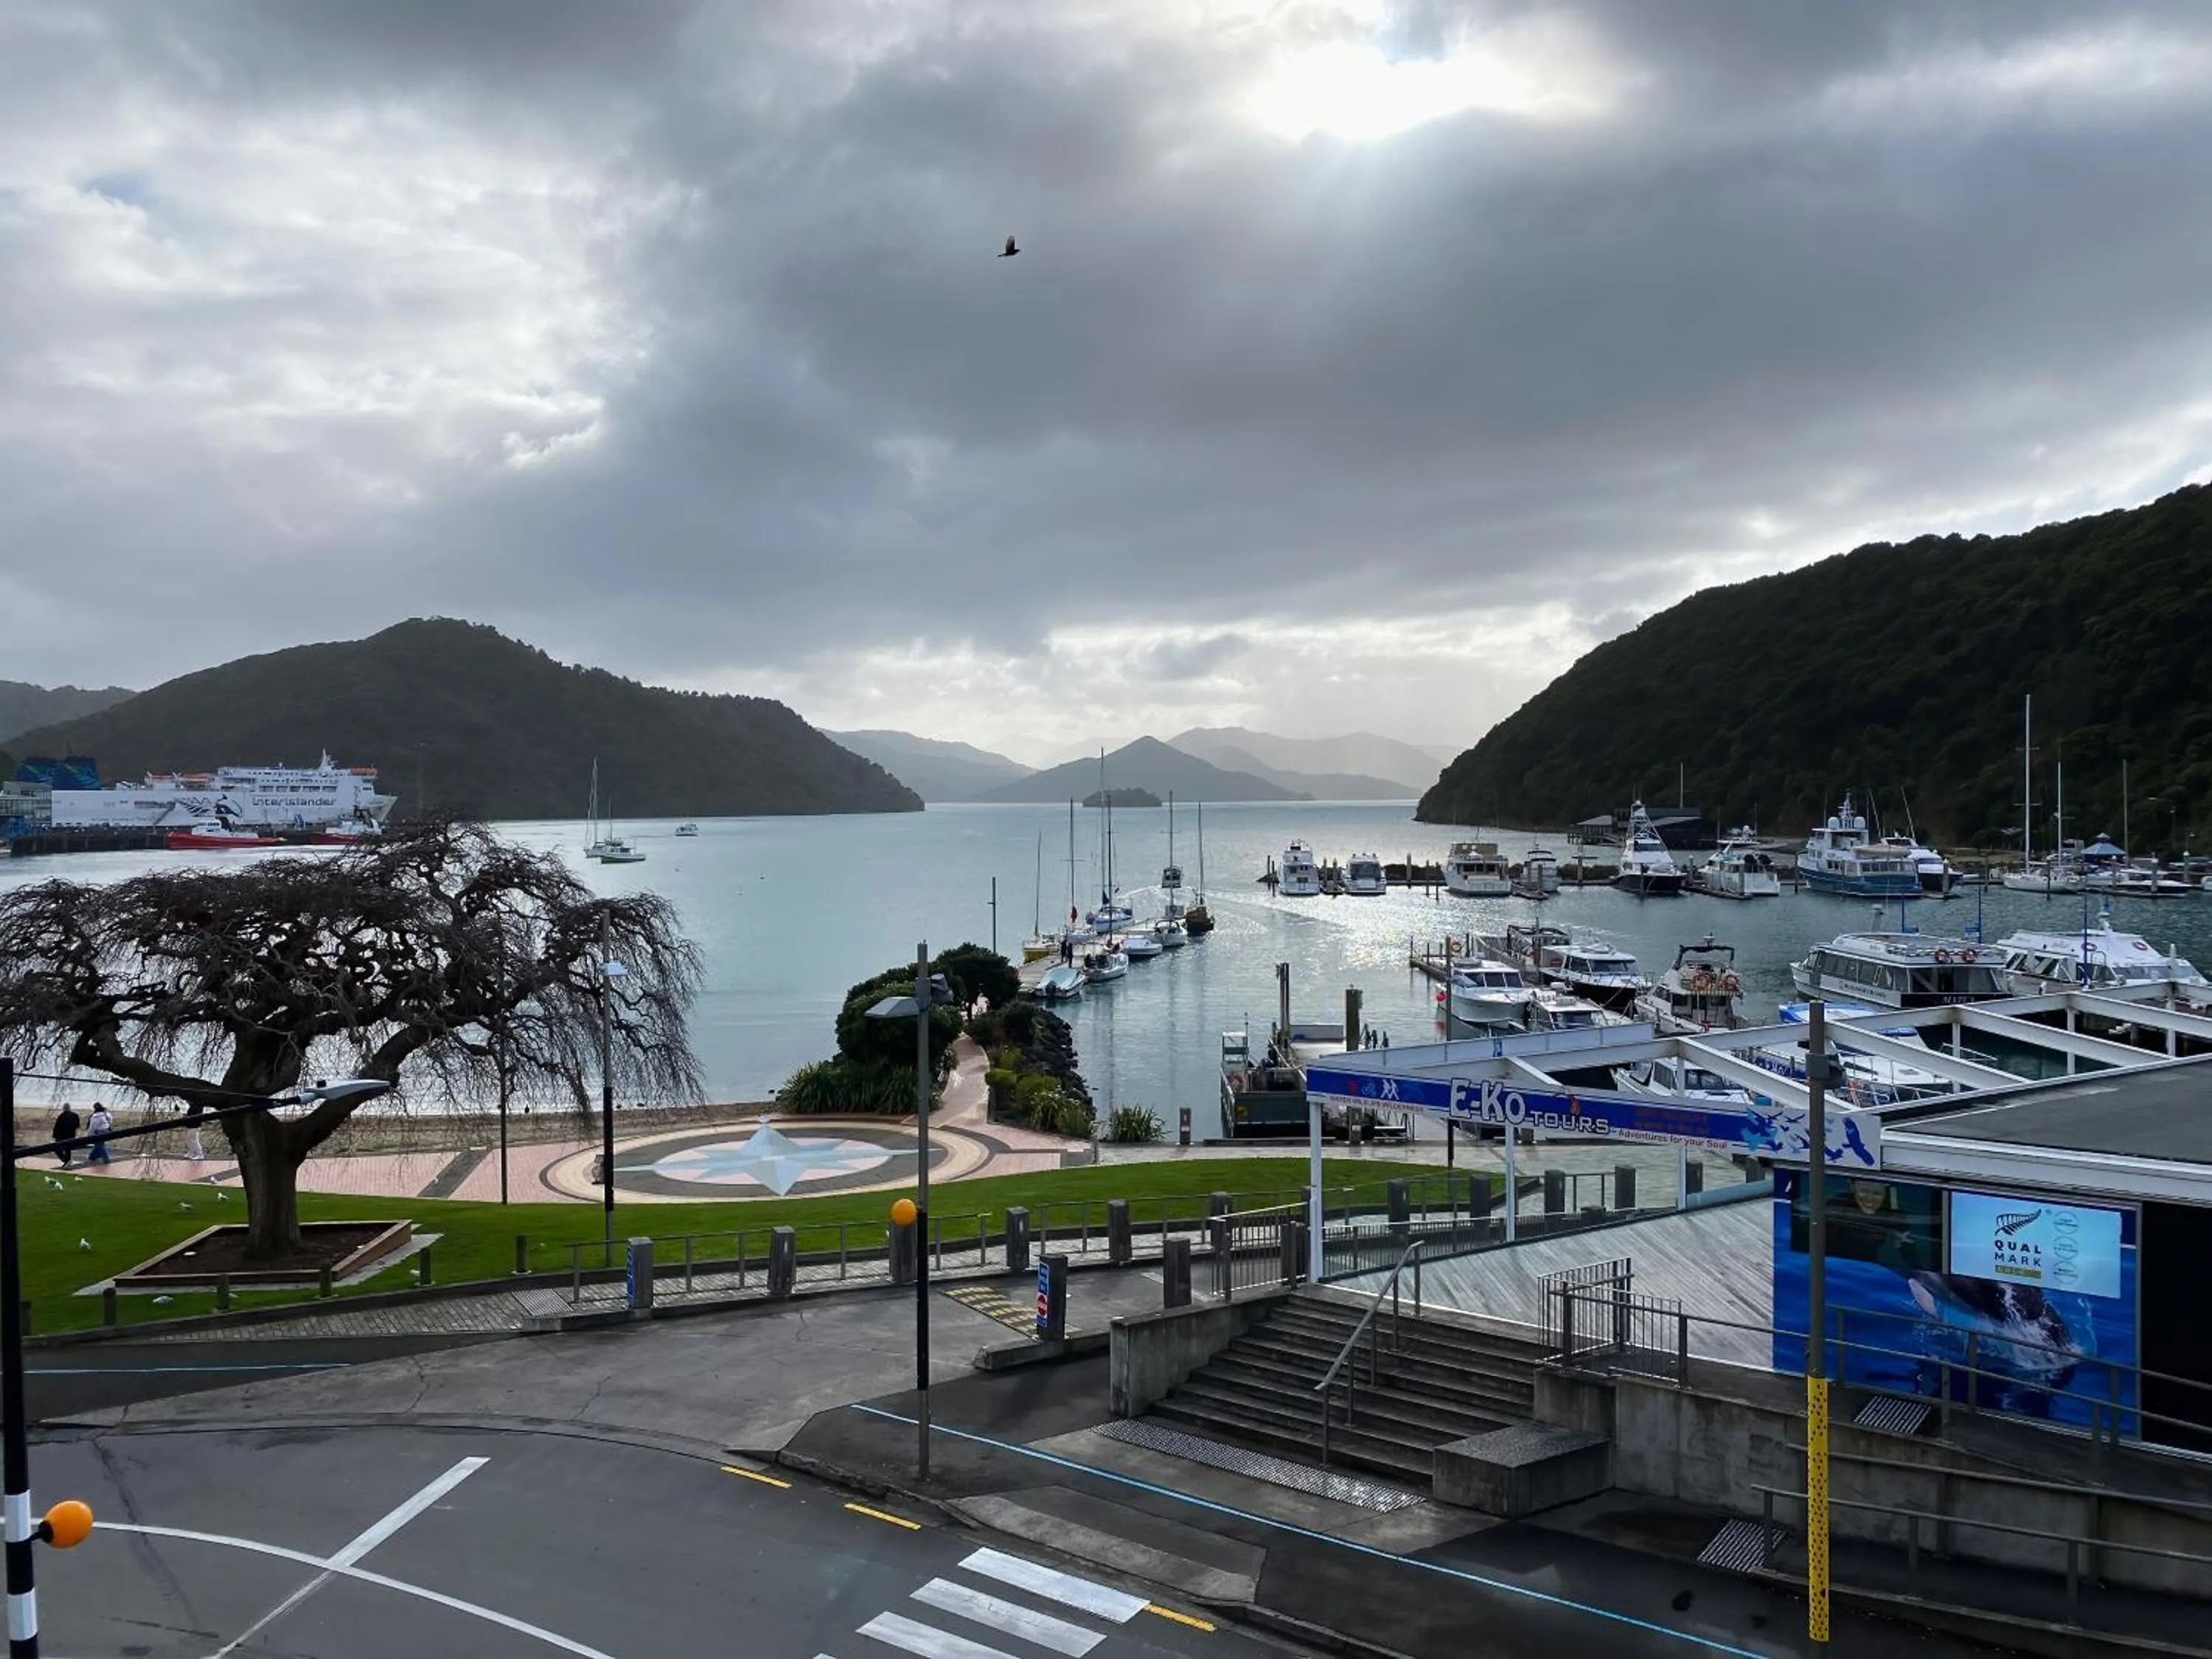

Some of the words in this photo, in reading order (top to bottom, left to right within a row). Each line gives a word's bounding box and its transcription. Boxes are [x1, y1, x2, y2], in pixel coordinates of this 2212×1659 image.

[1530, 1110, 1610, 1134] TOURS
[1618, 1129, 1668, 1142] Adventures
[1669, 1135, 1683, 1144] for
[1684, 1138, 1704, 1147] your
[1707, 1139, 1728, 1149] Soul
[1994, 1239, 2042, 1254] QUAL
[1994, 1251, 2041, 1267] MARK
